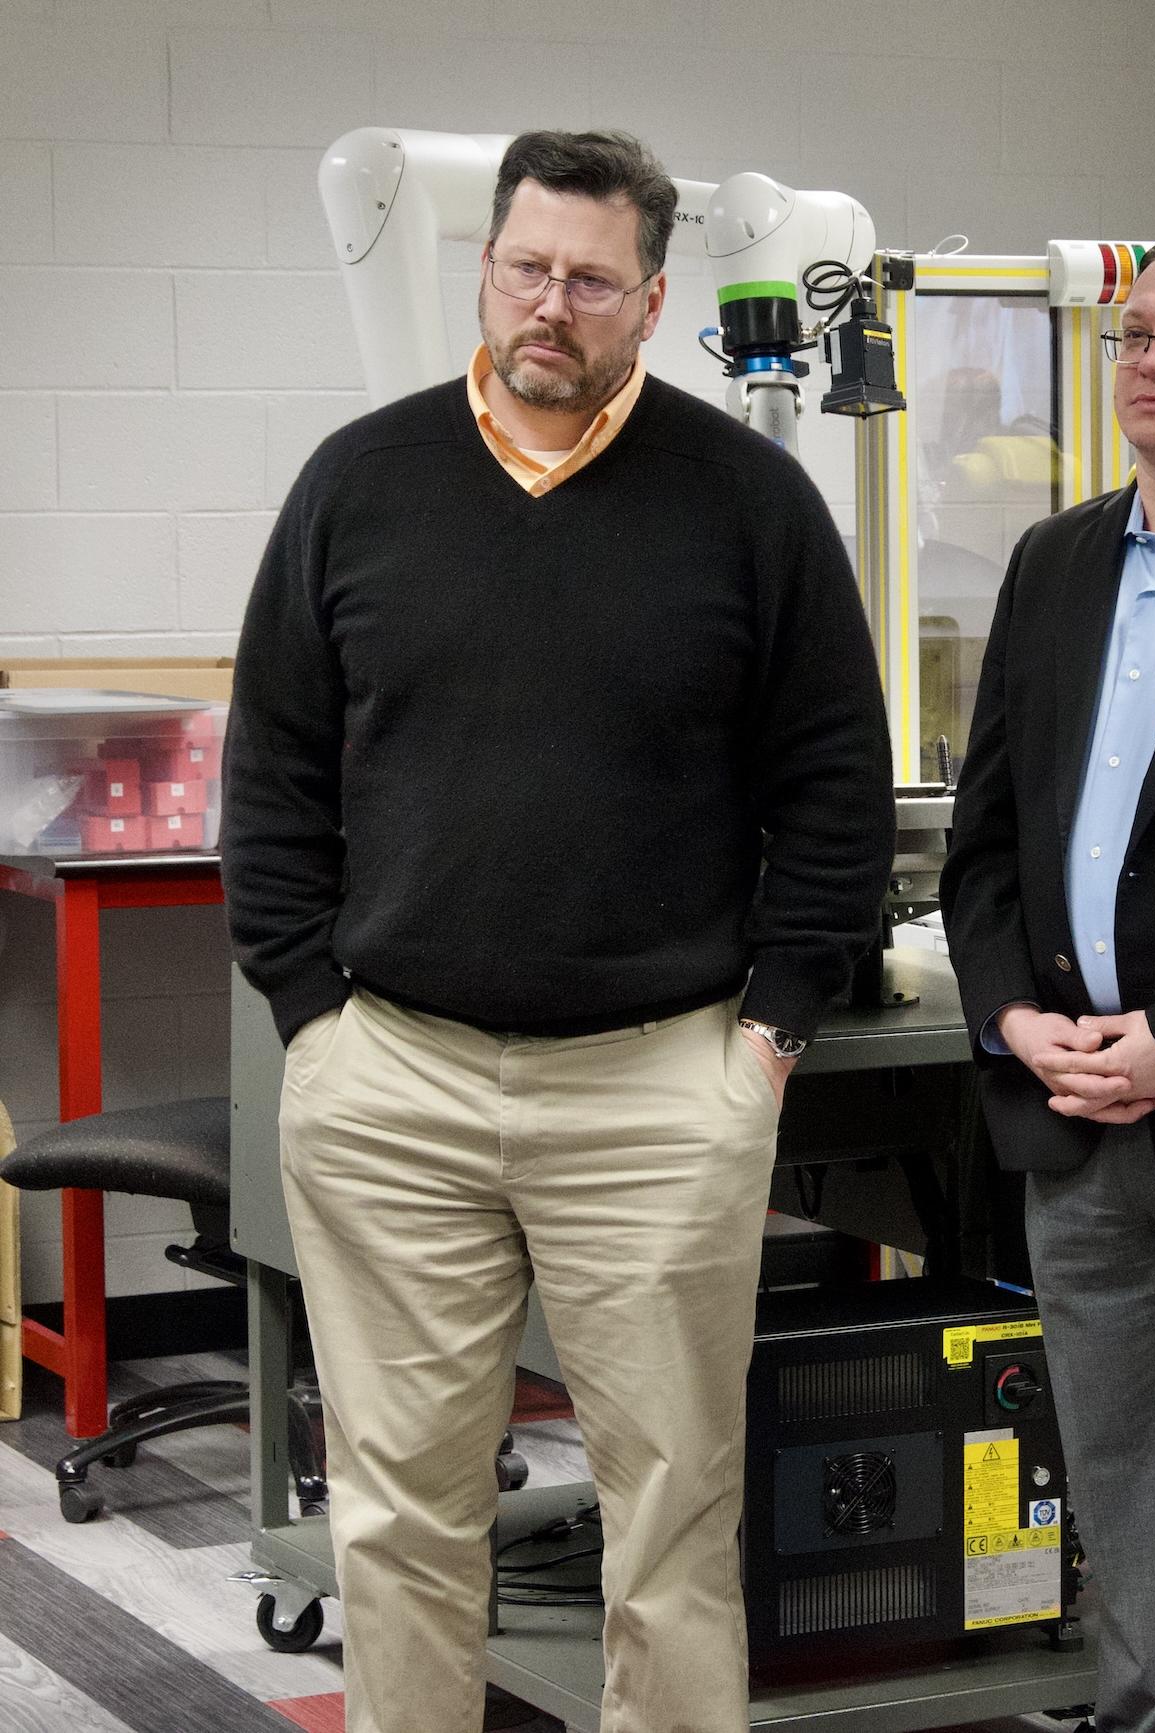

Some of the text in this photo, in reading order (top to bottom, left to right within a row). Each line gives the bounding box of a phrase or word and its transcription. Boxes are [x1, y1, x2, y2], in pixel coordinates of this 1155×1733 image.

[673, 211, 705, 225] RX-10
[971, 1617, 993, 1625] FANUC
[994, 1612, 1040, 1623] CORPORATION
